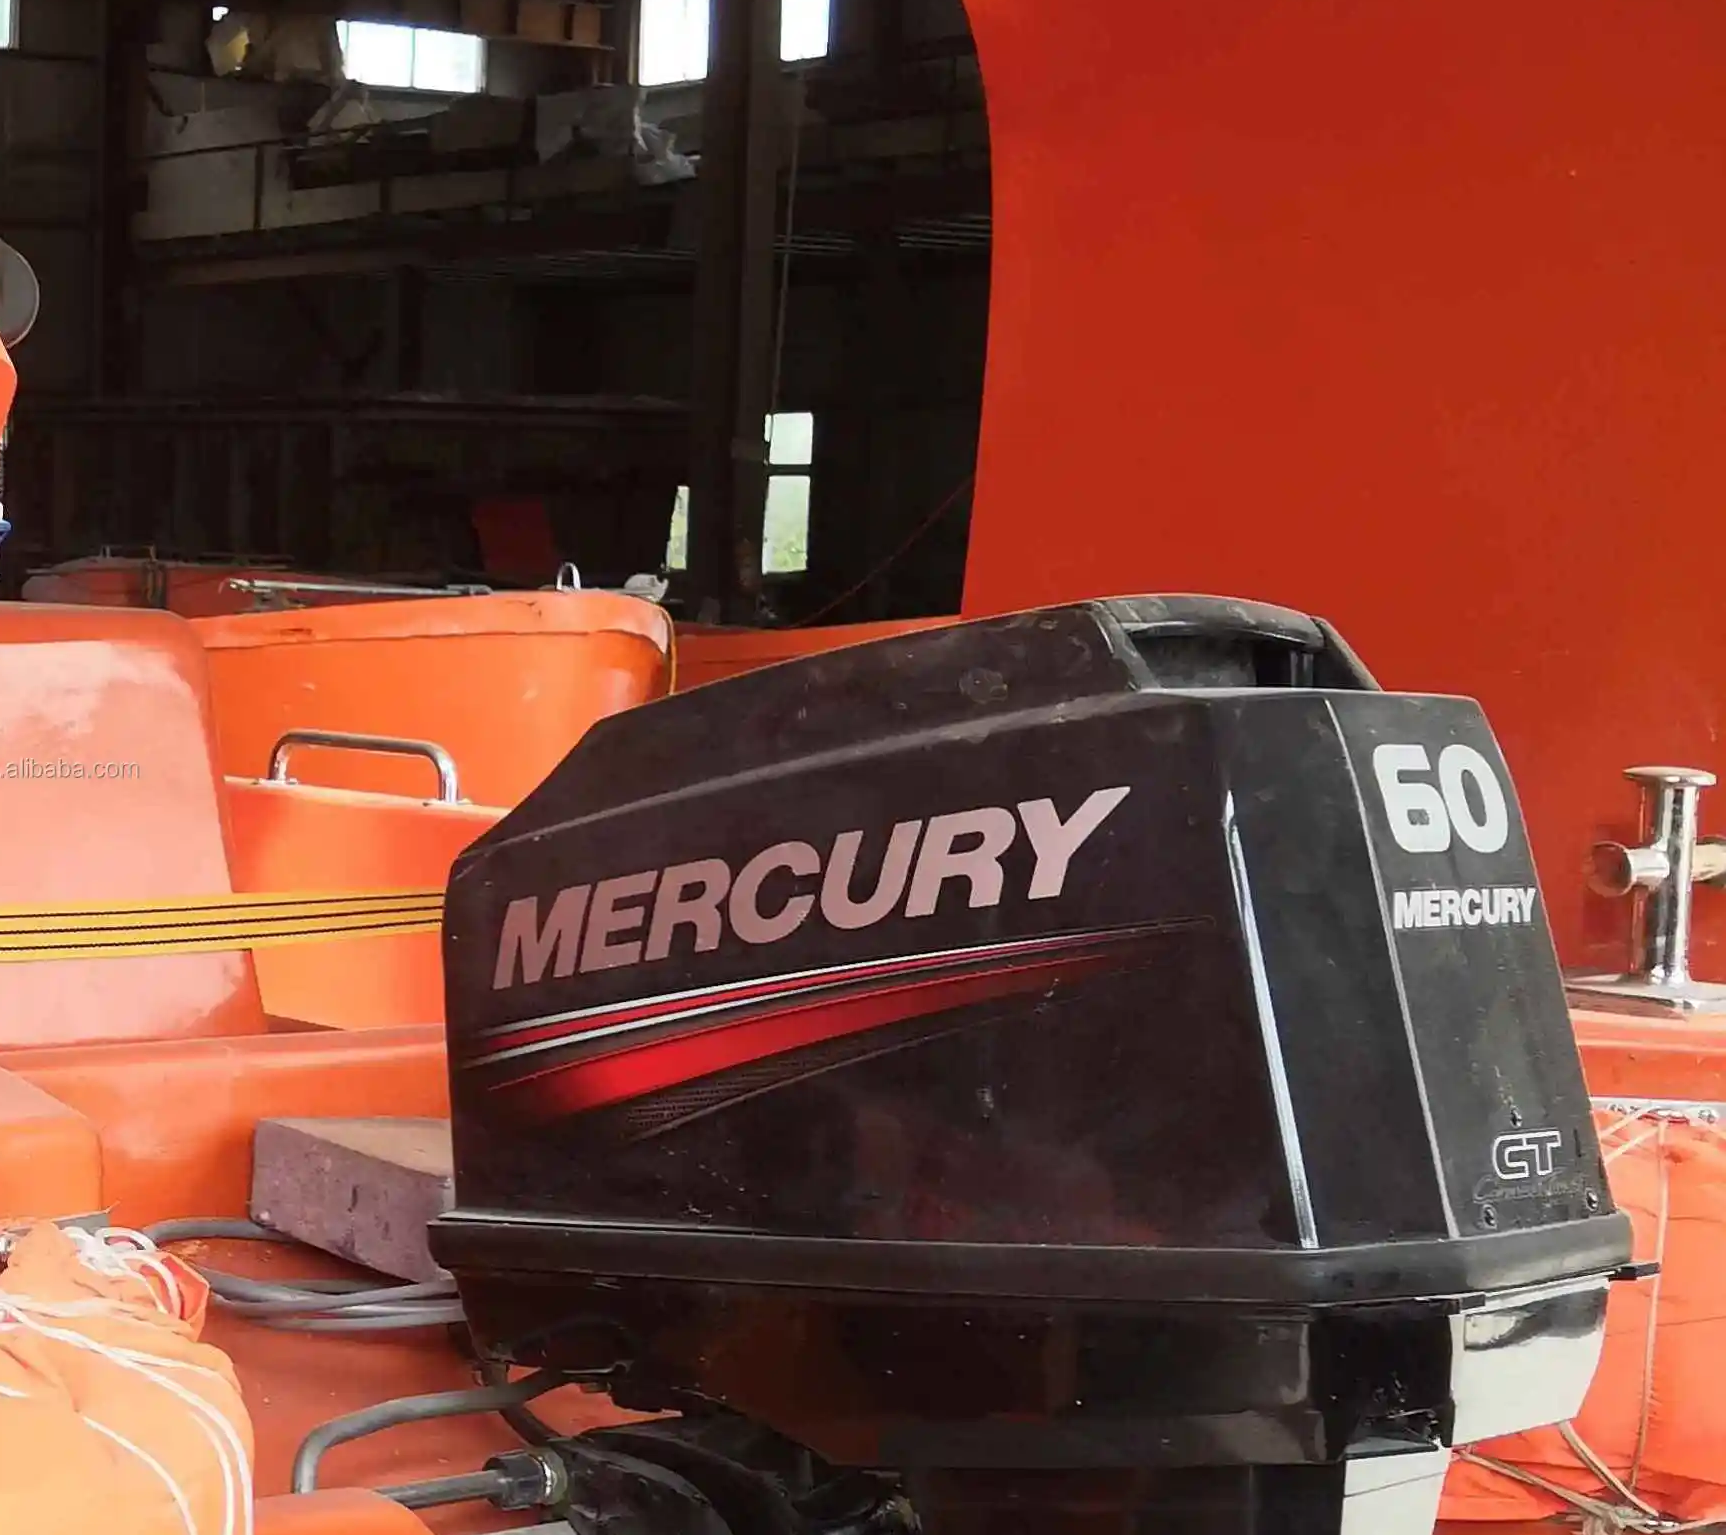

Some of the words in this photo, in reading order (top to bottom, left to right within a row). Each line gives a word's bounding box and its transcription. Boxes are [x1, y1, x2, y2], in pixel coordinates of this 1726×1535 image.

[1372, 744, 1509, 854] 60
[491, 785, 1131, 990] MERCURY
[1393, 888, 1536, 930] MERCURY
[1492, 1130, 1562, 1180] CT
